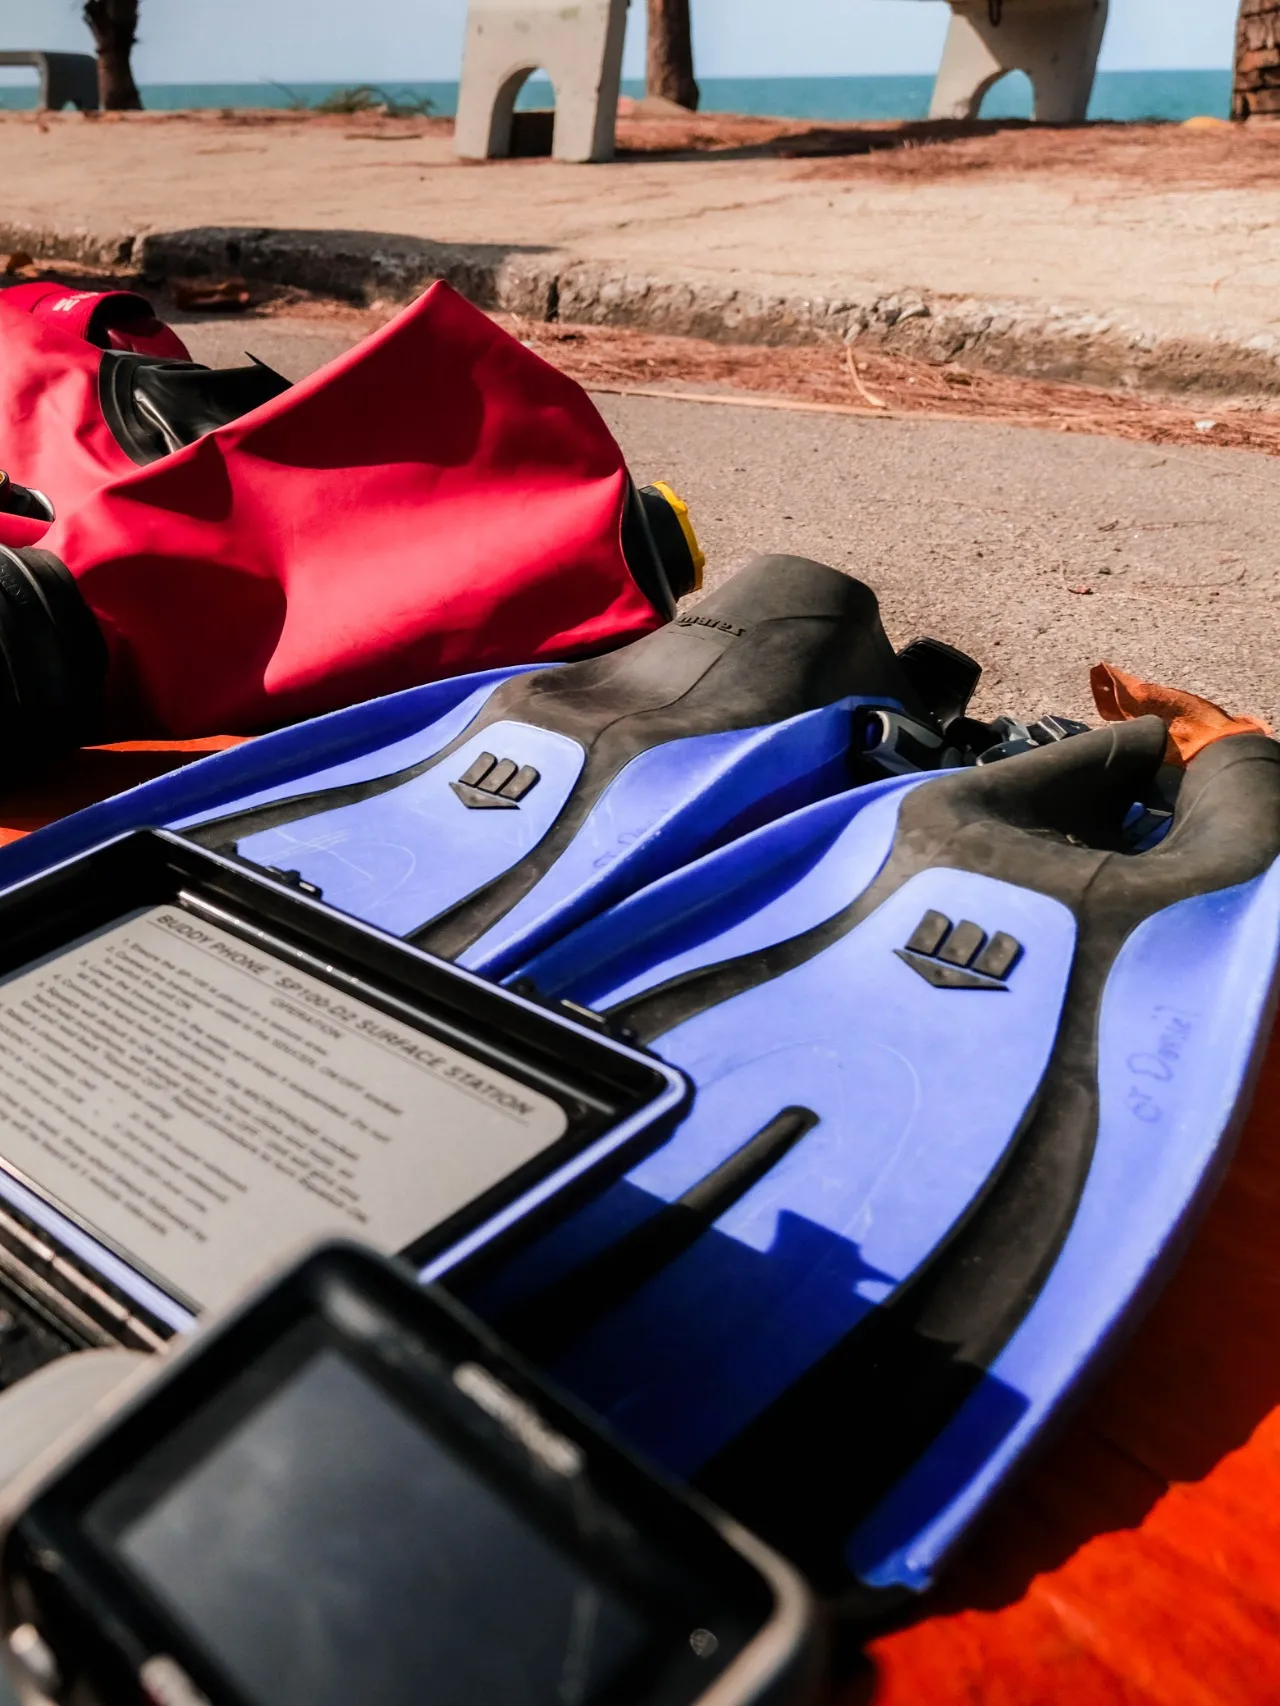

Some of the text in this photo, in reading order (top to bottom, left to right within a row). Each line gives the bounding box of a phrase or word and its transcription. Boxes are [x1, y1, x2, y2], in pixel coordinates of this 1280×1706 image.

[157, 915, 214, 944] BUDDY
[356, 1020, 446, 1066] SURFACE
[444, 1066, 535, 1114] STATION
